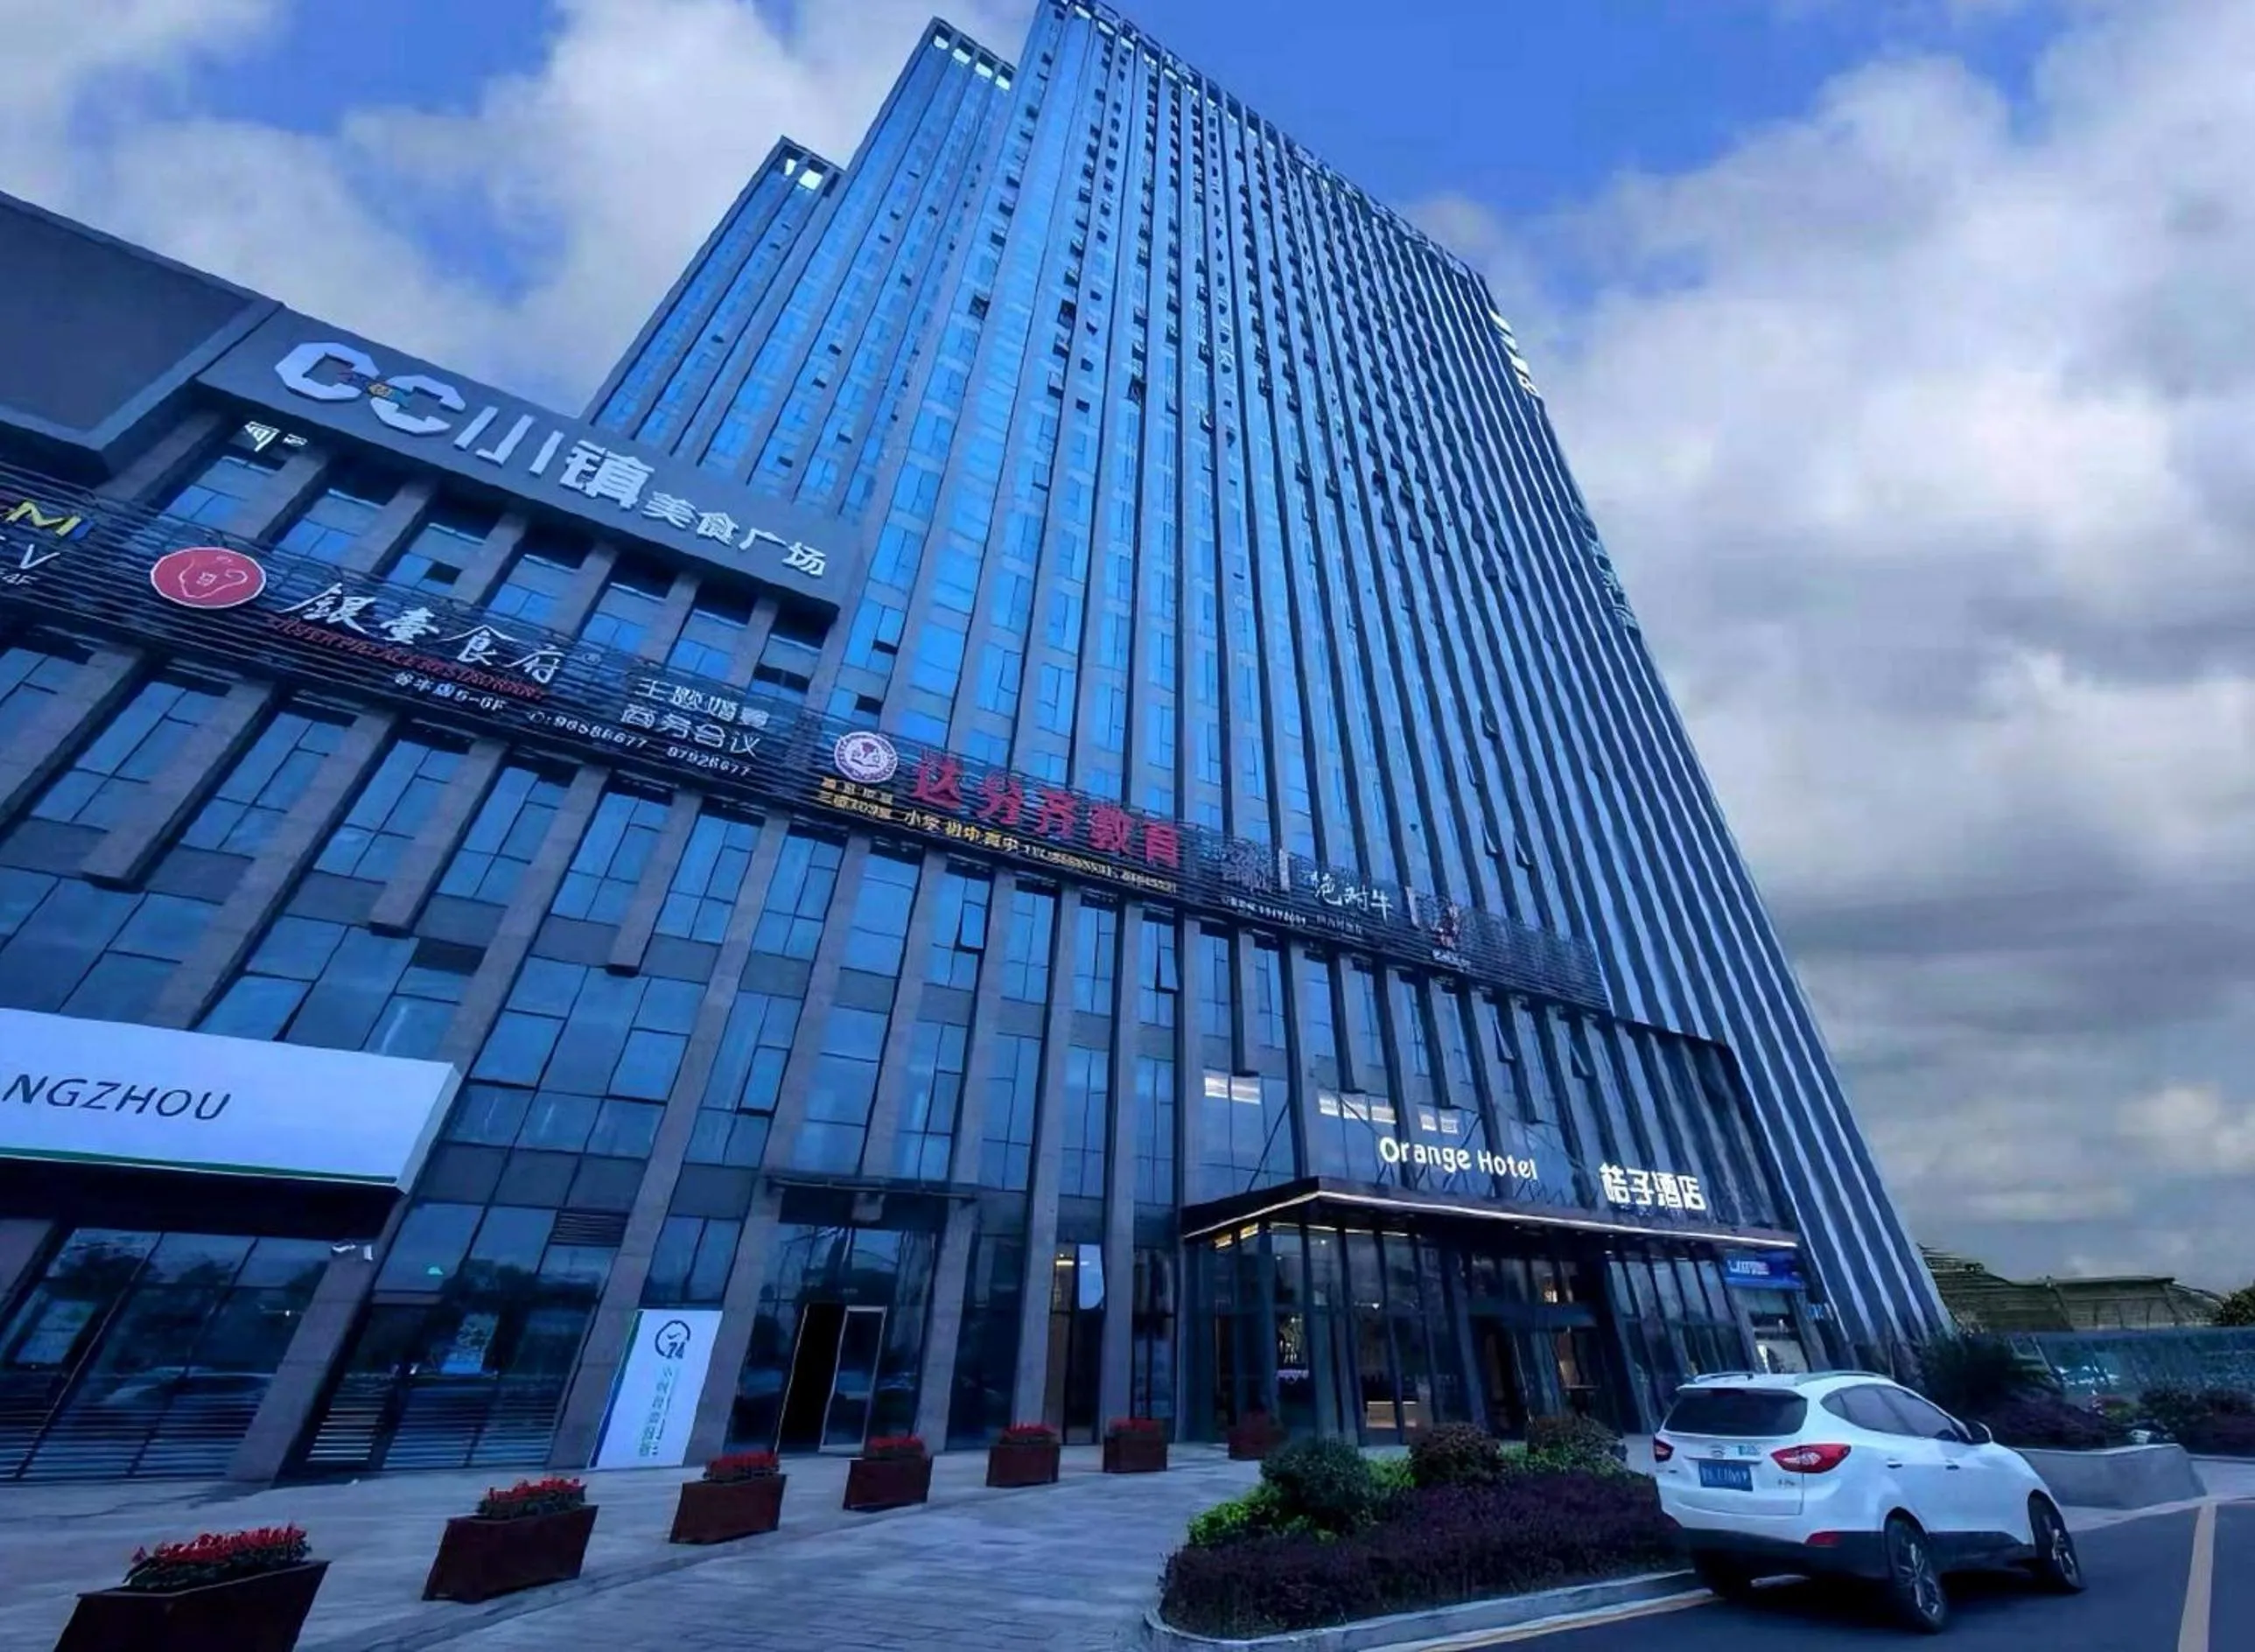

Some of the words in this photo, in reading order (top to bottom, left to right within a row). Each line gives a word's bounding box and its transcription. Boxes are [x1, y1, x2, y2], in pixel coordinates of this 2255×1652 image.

[641, 491, 826, 578] 美食广场
[621, 703, 761, 757] 商务会议
[2, 1074, 232, 1121] NGZHOU
[1379, 1137, 1472, 1173] Orange
[1477, 1150, 1538, 1180] Hotel
[1599, 1162, 1707, 1211] 桔子酒店
